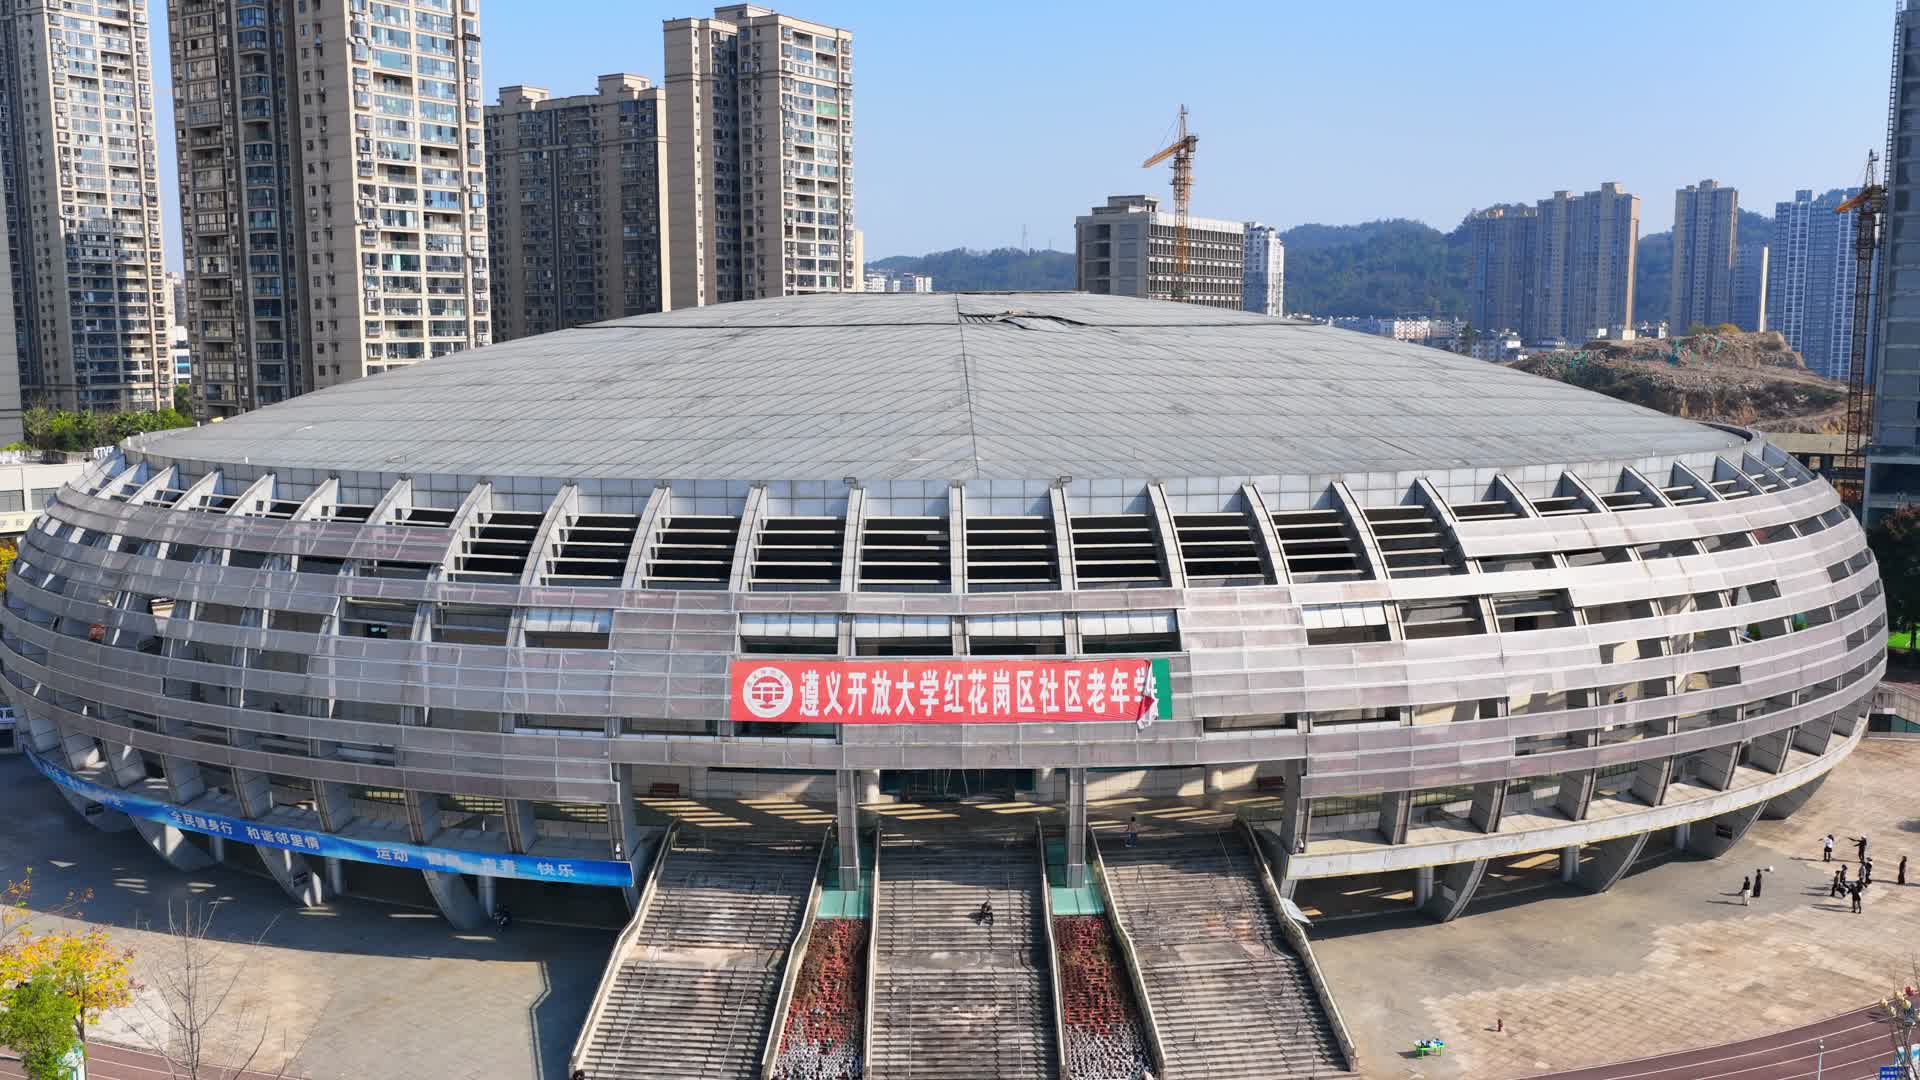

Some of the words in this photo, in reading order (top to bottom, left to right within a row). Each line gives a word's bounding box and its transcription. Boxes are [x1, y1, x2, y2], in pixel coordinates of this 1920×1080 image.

[169, 810, 233, 835] 全民健身行
[245, 826, 320, 850] 和谐邻里情
[376, 847, 409, 863] 运动
[536, 862, 576, 878] 快乐
